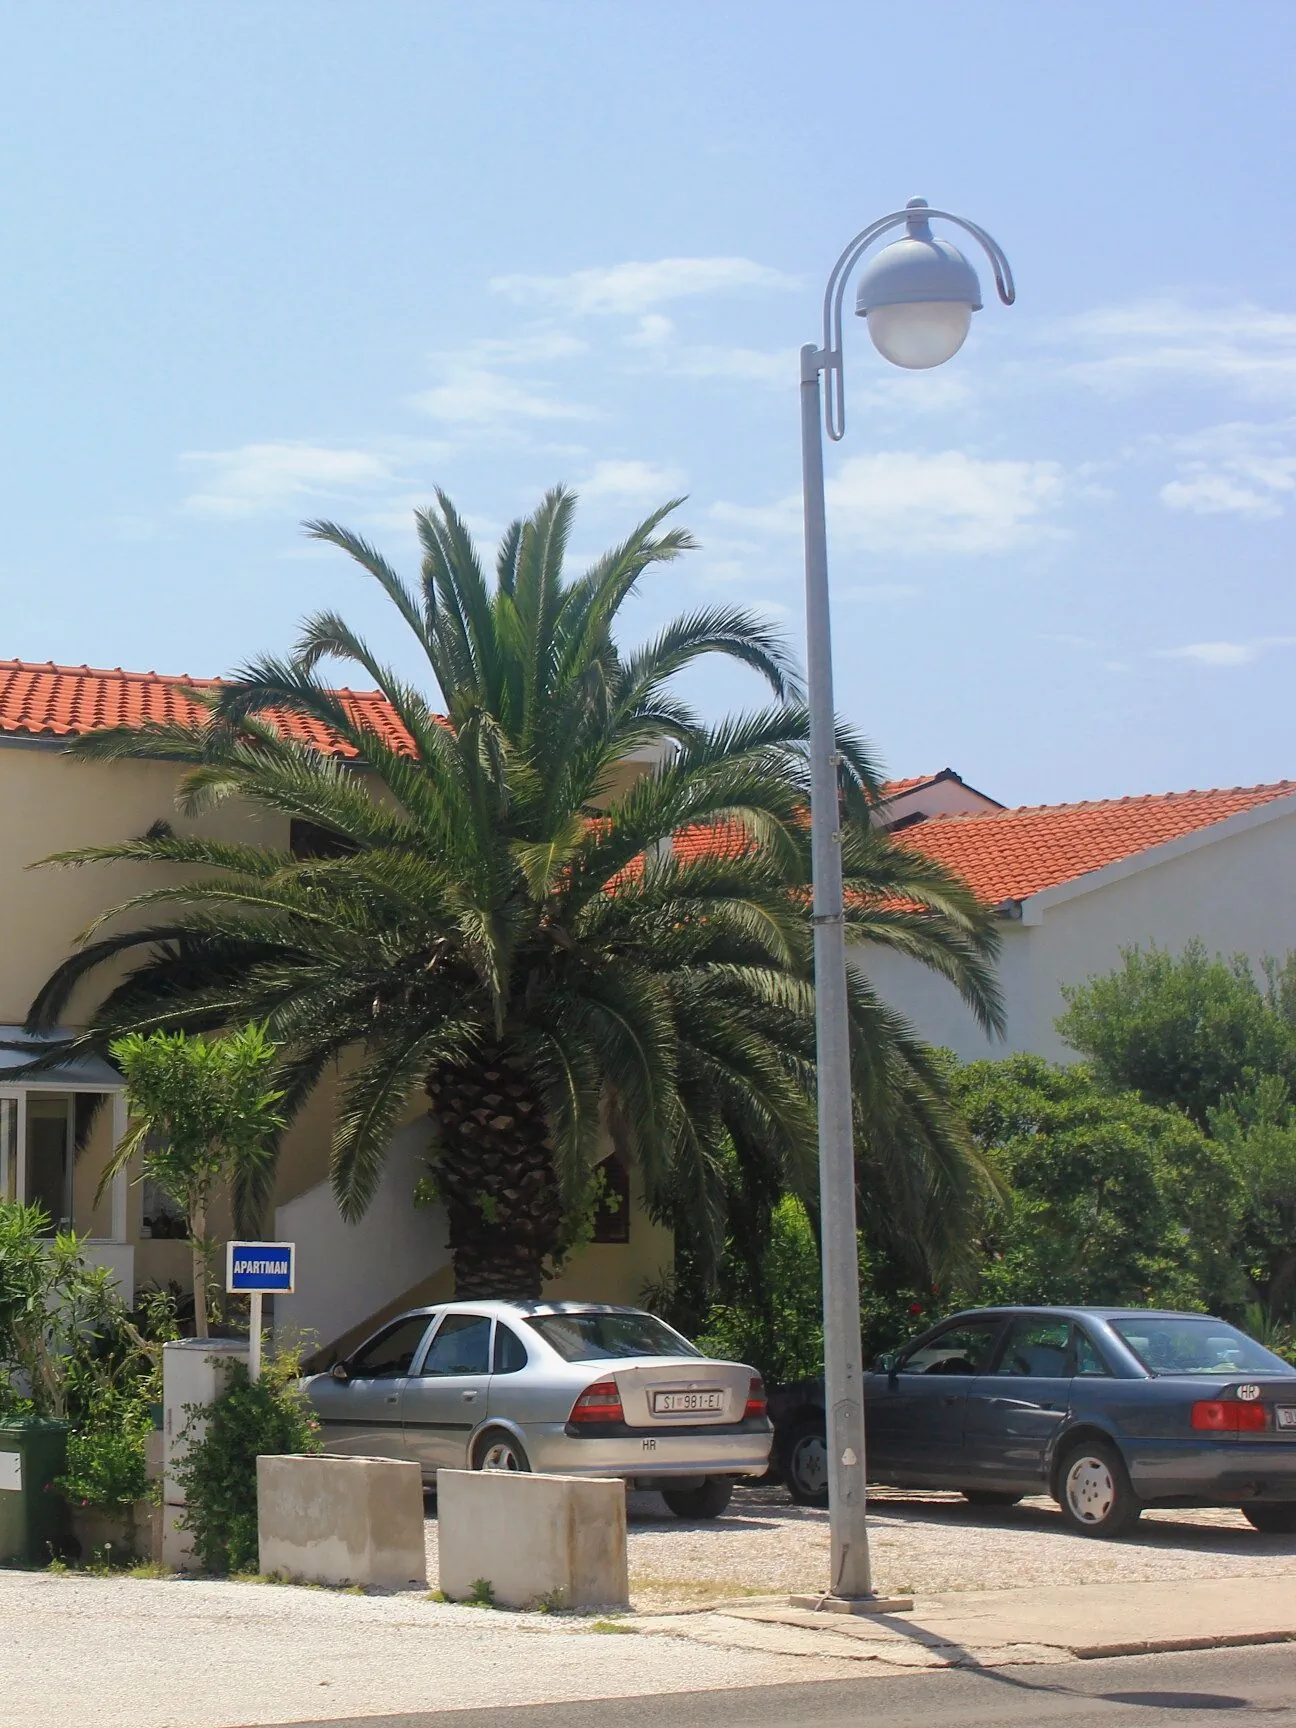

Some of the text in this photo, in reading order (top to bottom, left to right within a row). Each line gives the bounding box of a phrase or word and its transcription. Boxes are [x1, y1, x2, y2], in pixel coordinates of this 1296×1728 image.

[234, 1261, 287, 1274] APARTMAN
[1241, 1385, 1255, 1399] HR
[664, 1396, 675, 1409] SI
[642, 1439, 656, 1451] HR
